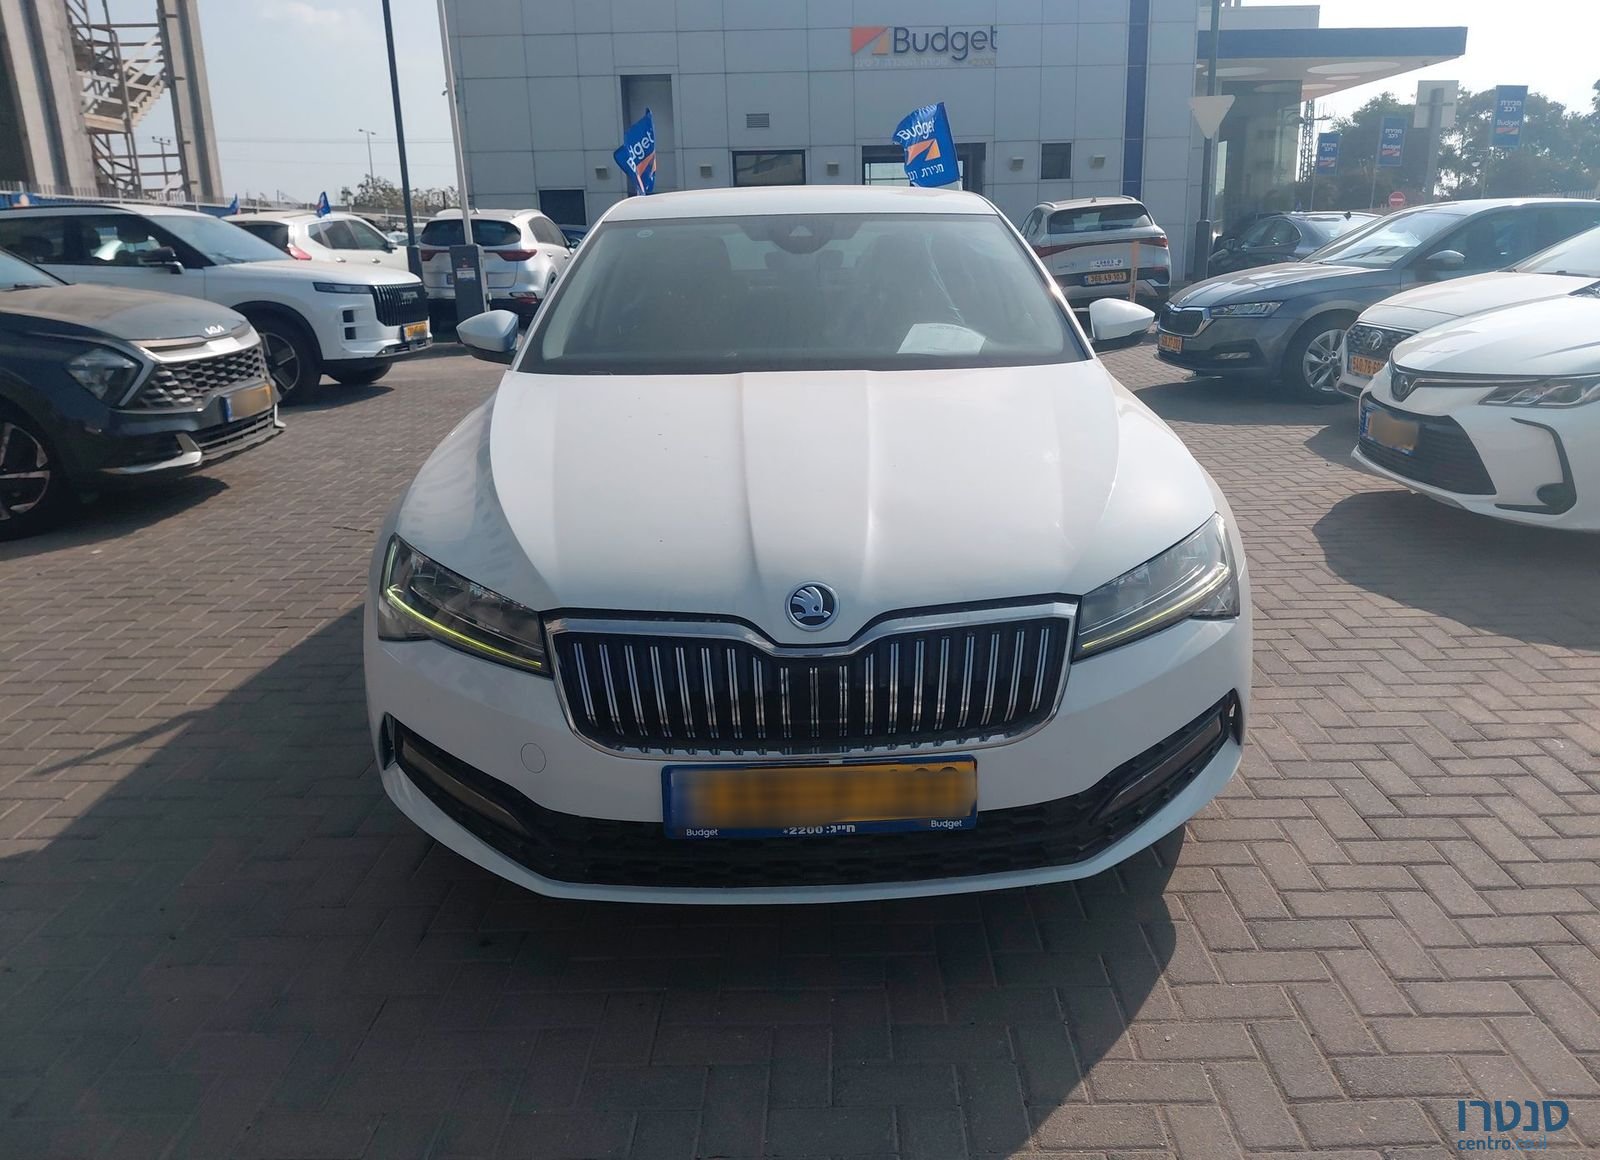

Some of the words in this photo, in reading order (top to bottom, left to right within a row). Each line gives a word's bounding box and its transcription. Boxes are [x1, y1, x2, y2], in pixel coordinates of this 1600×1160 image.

[893, 25, 998, 61] Budget
[896, 117, 935, 140] Budget
[930, 819, 963, 830] Budget
[686, 828, 719, 839] Budget
